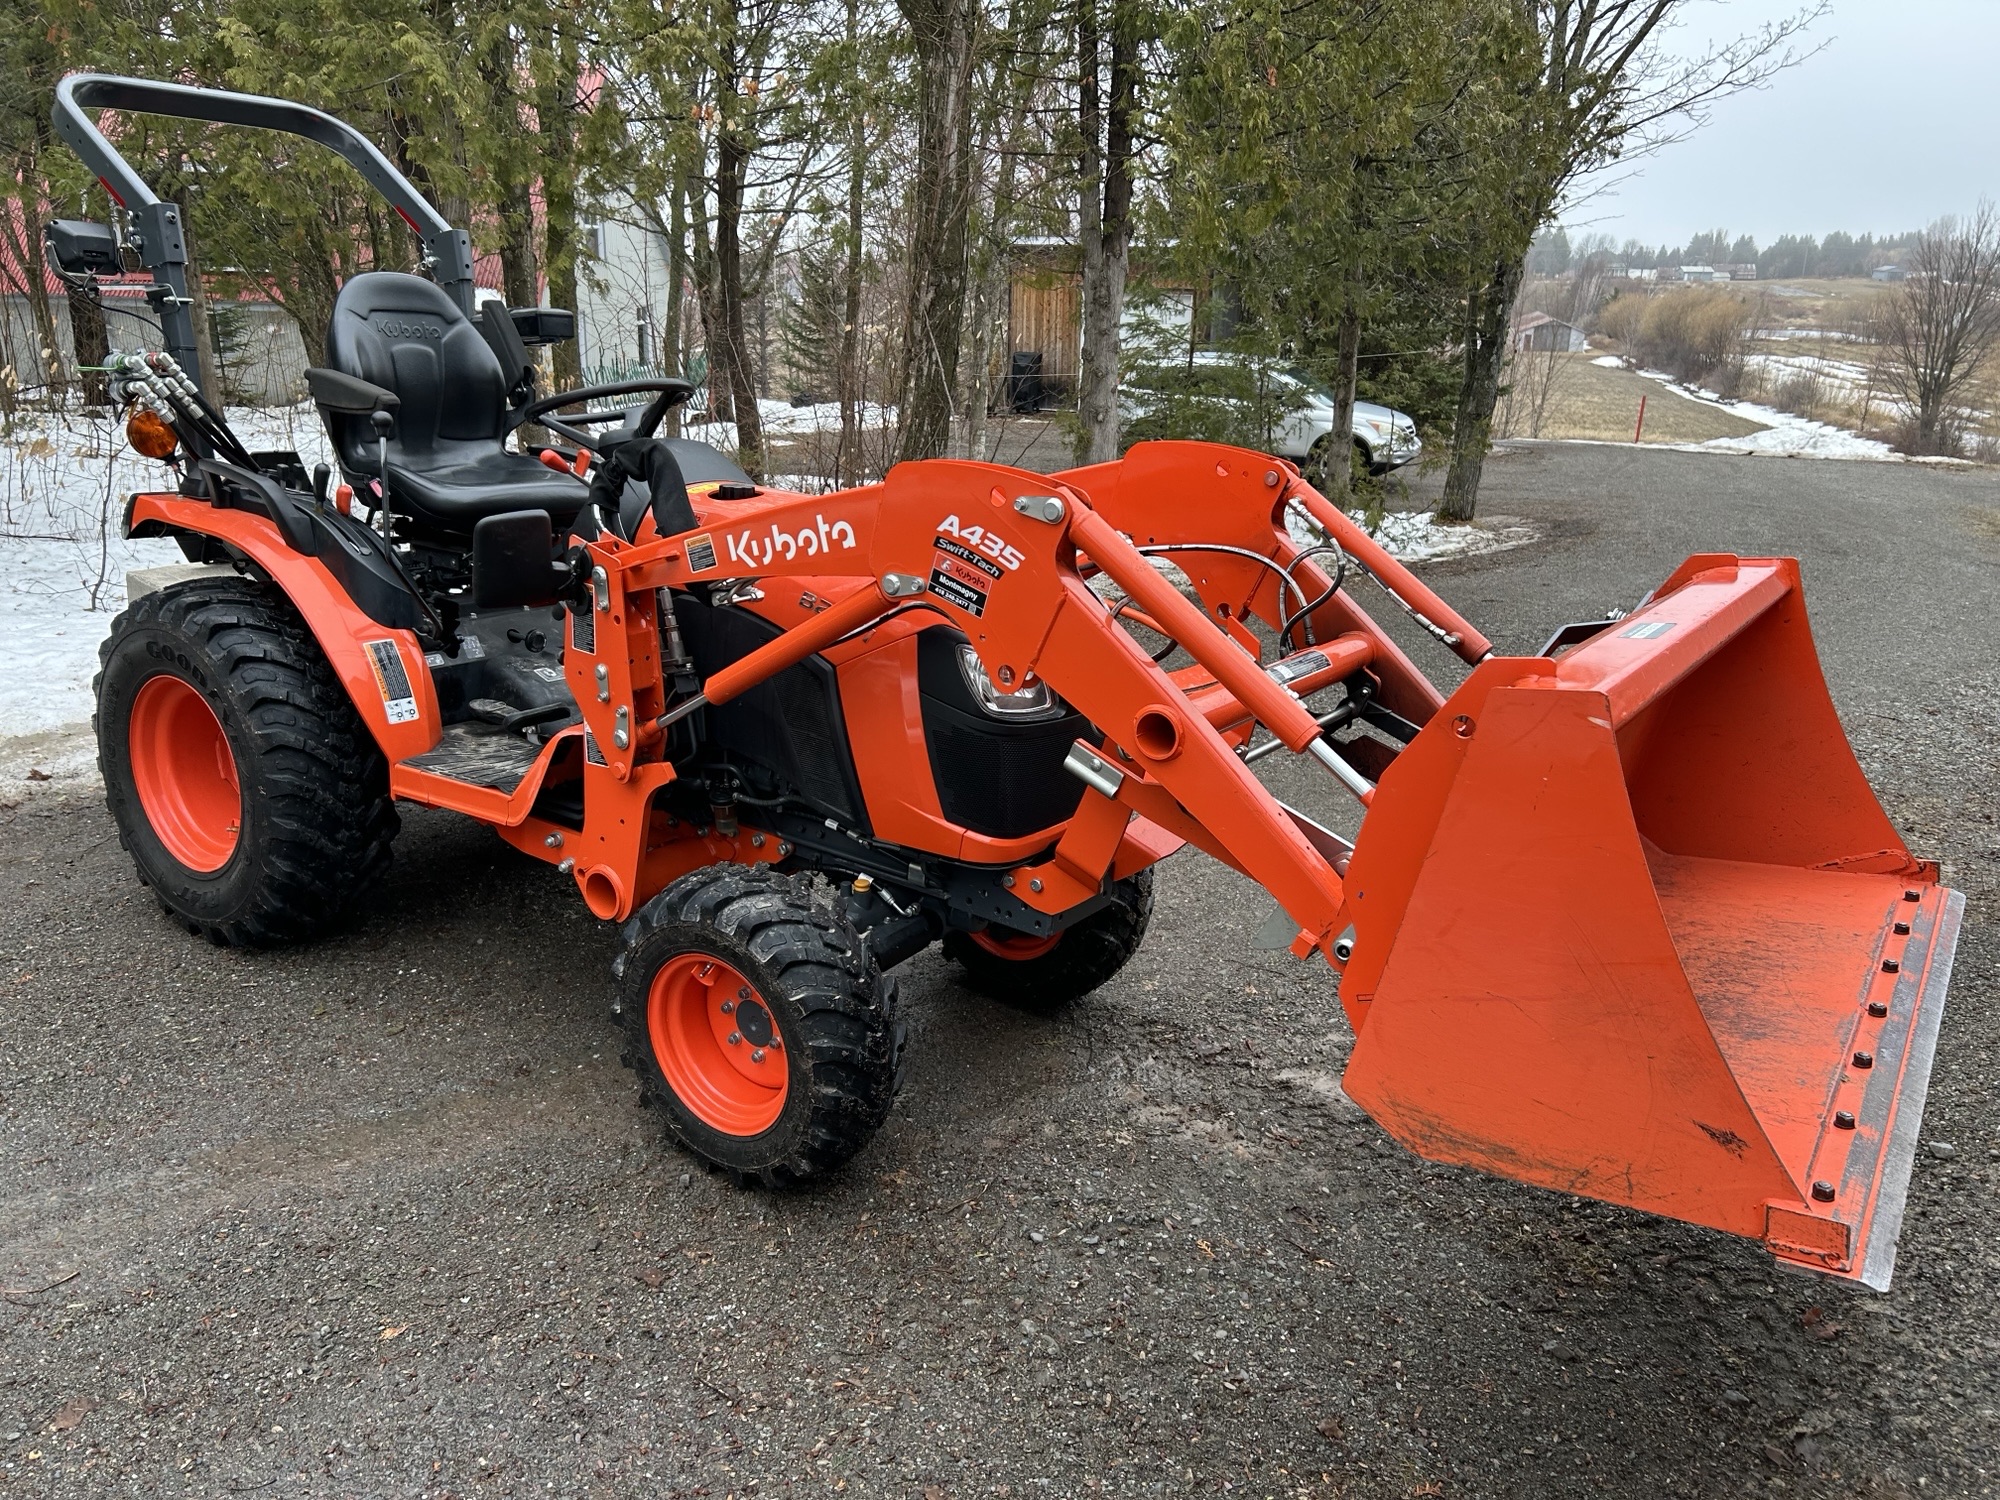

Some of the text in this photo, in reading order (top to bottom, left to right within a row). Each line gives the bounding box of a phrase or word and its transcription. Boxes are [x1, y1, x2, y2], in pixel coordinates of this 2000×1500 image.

[376, 319, 442, 339] Kubota
[726, 514, 856, 568] Kubota
[937, 514, 1026, 571] A435
[937, 538, 999, 577] Swift-Tach
[938, 574, 978, 601] Montmagny
[955, 566, 985, 589] Kubota
